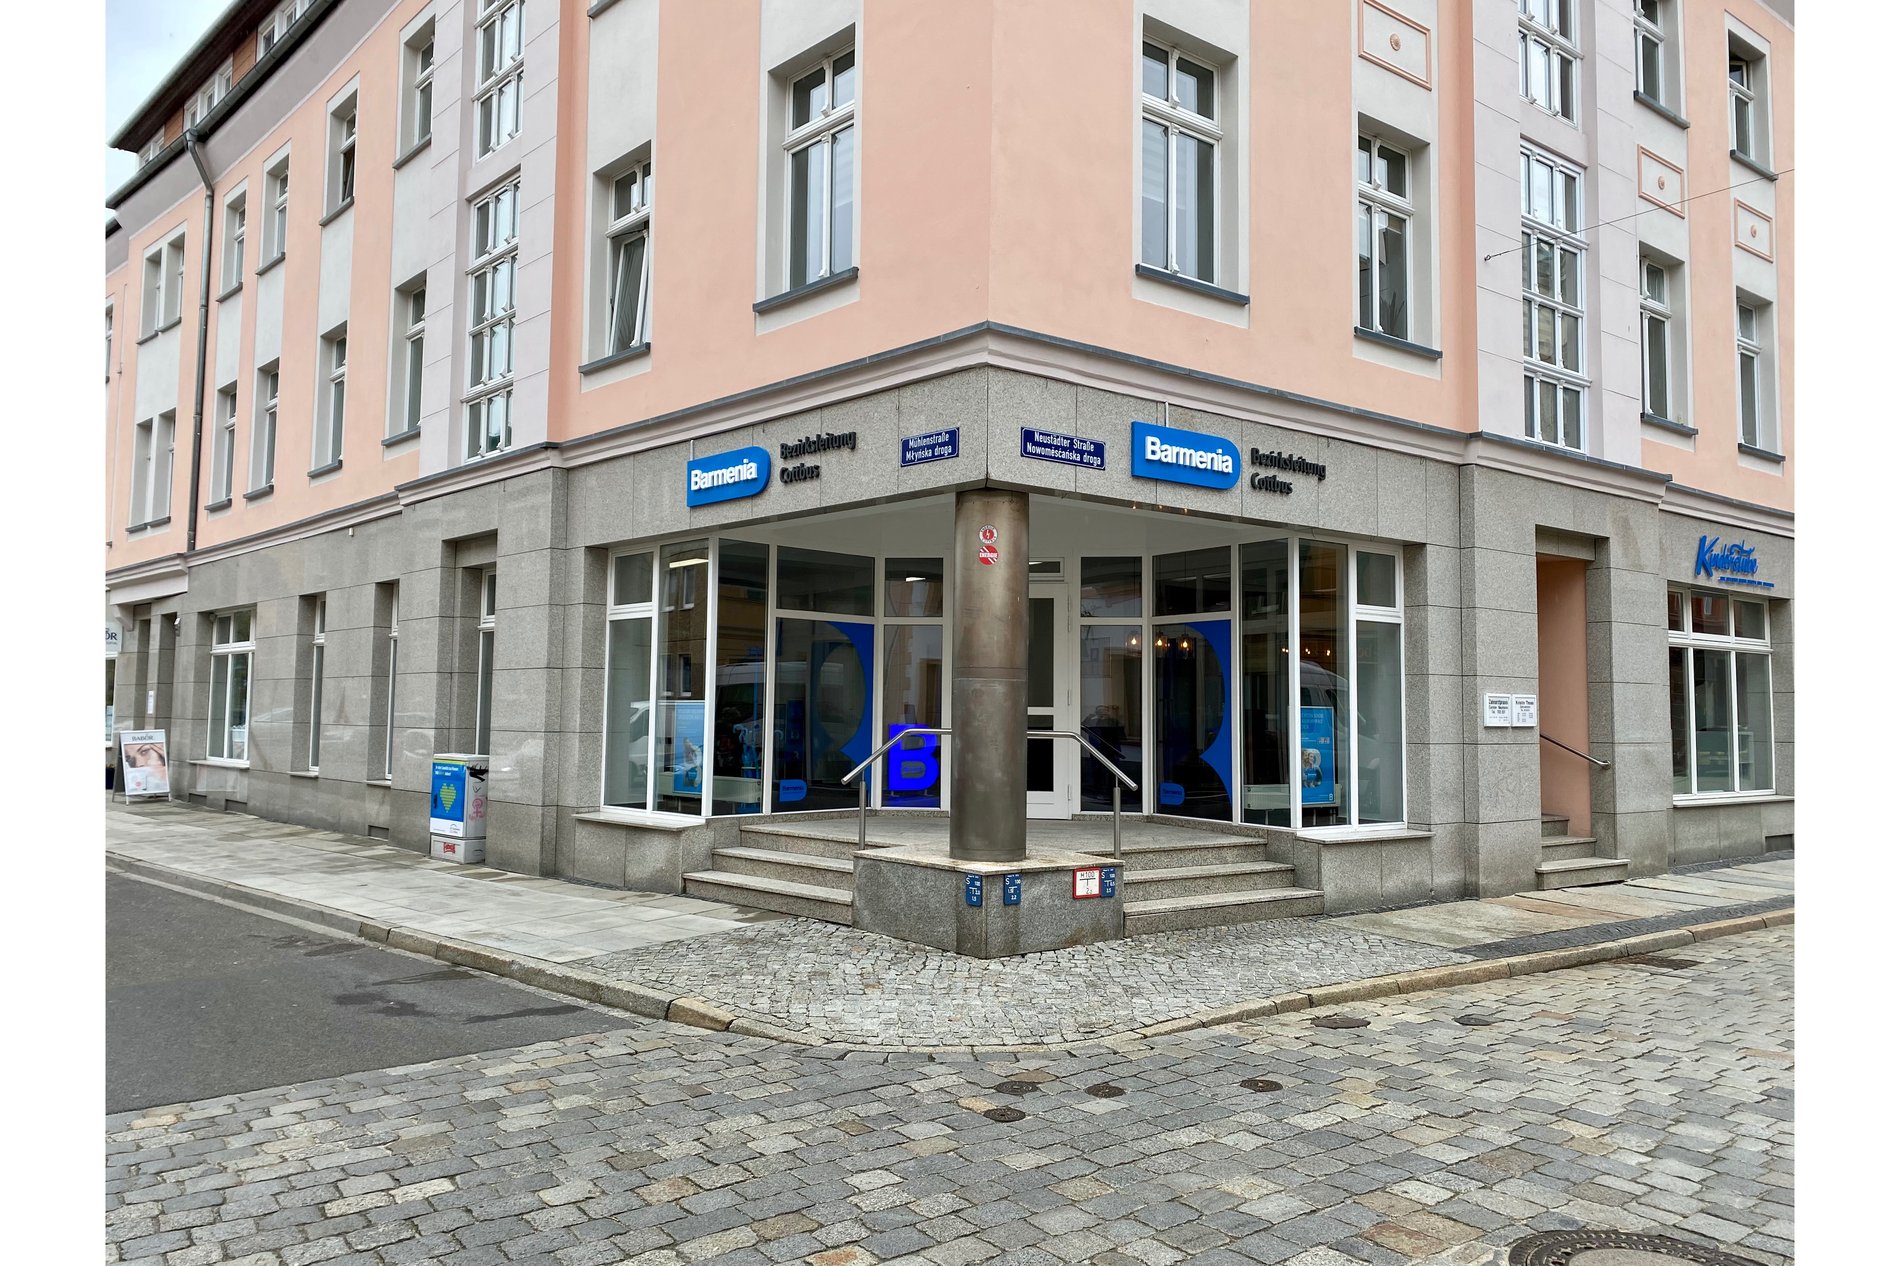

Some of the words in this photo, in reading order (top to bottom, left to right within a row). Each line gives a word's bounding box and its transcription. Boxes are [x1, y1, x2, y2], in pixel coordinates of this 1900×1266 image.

[780, 432, 856, 459] Bezirksleitung
[909, 431, 949, 448] Mühlenstraße
[1034, 431, 1071, 447] Neustädter
[1073, 439, 1094, 452] Straße
[934, 445, 952, 456] droga
[1083, 452, 1101, 466] droga
[1145, 435, 1233, 474] Barmenia
[691, 458, 758, 491] Barmenia
[780, 463, 820, 483] Cottbus
[1251, 447, 1326, 481] Bezirksleitung
[1251, 472, 1293, 494] Cottbus
